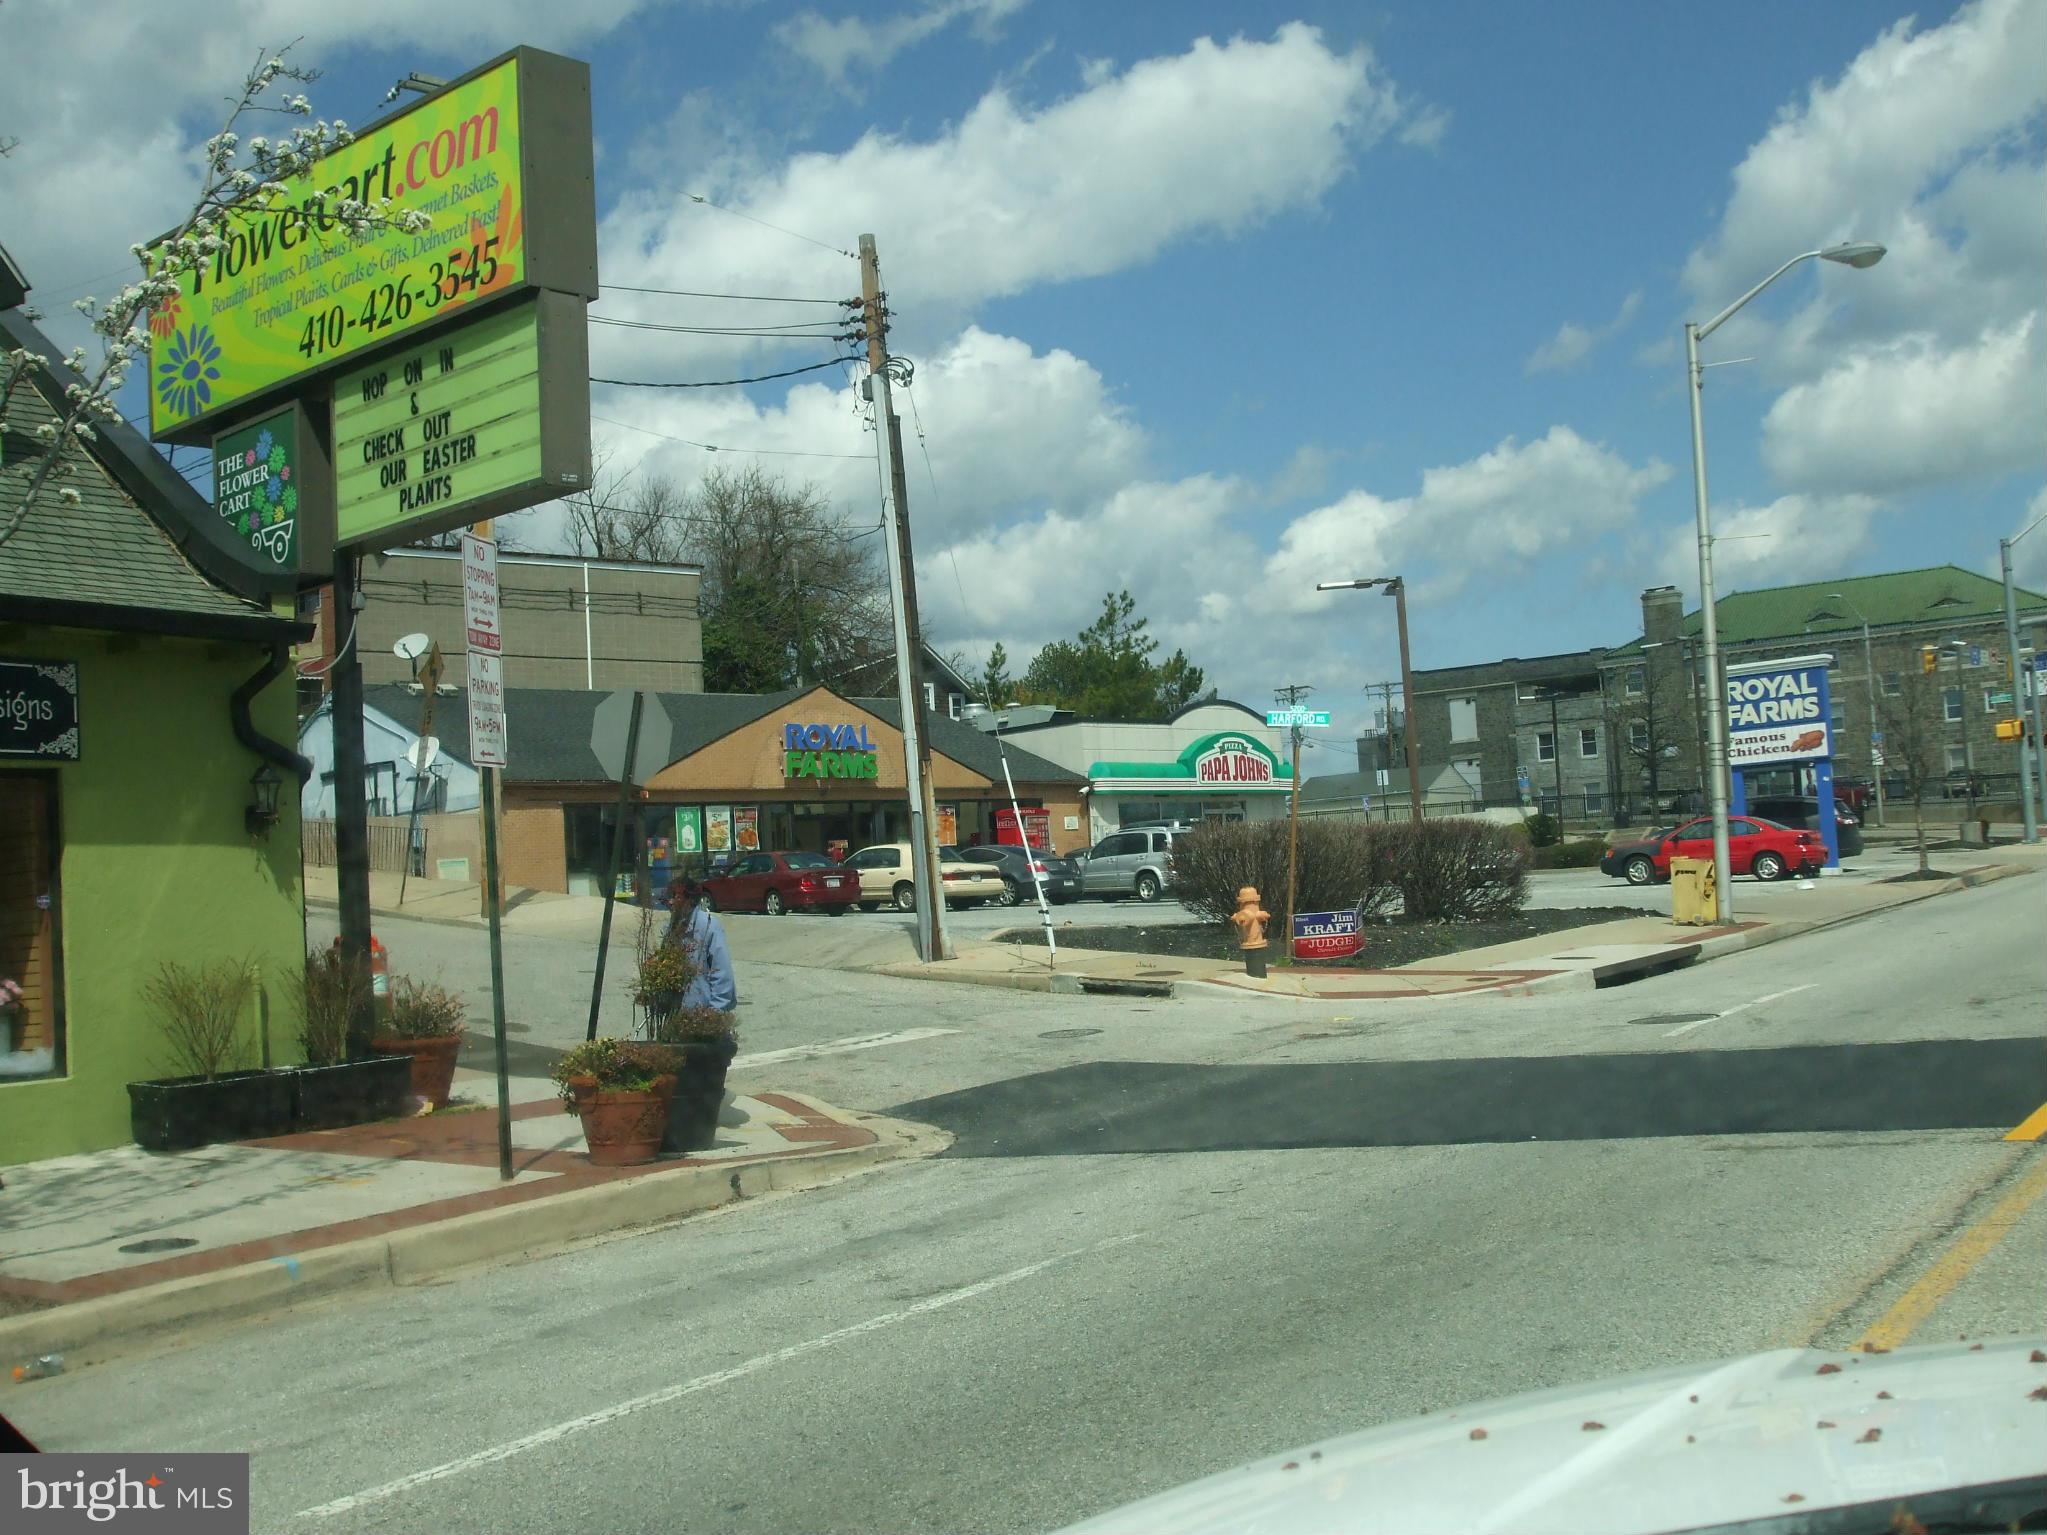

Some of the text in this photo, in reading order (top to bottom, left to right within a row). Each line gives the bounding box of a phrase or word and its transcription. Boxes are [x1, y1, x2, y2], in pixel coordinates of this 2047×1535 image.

[193, 106, 499, 295] lowercart.com
[212, 277, 254, 316] Beautiful
[451, 170, 499, 205] Baskets,
[254, 292, 293, 328] Tropical
[331, 262, 364, 293] Cards
[413, 212, 468, 257] Delivered
[299, 236, 499, 358] 410-426-3545
[362, 347, 454, 402] HOP ON IN
[410, 392, 419, 416] &
[363, 411, 451, 464] CHECK OUT
[218, 452, 244, 477] THE
[380, 434, 476, 489] OUR EASTER
[219, 464, 270, 498] FLOWER
[399, 475, 452, 513] PLANTS
[219, 491, 252, 517] CART
[473, 544, 485, 561] NO
[466, 565, 495, 587] STOPPING
[467, 586, 496, 606] 7AM-9AM
[480, 658, 488, 673] NO
[472, 678, 499, 696] PARKING
[1728, 672, 1818, 703] ROYAL
[1271, 713, 1315, 724] HARFORD
[1728, 696, 1820, 727] FARMS
[474, 716, 502, 734] 9AM-5PM
[784, 723, 877, 750] ROYAL
[1728, 744, 1790, 758] Chicken
[785, 751, 878, 778] FARMS
[1201, 755, 1231, 782] PAPA
[1303, 922, 1354, 935] KRAFT
[1331, 914, 1353, 923] Jim
[1308, 936, 1354, 949] JUDGE
